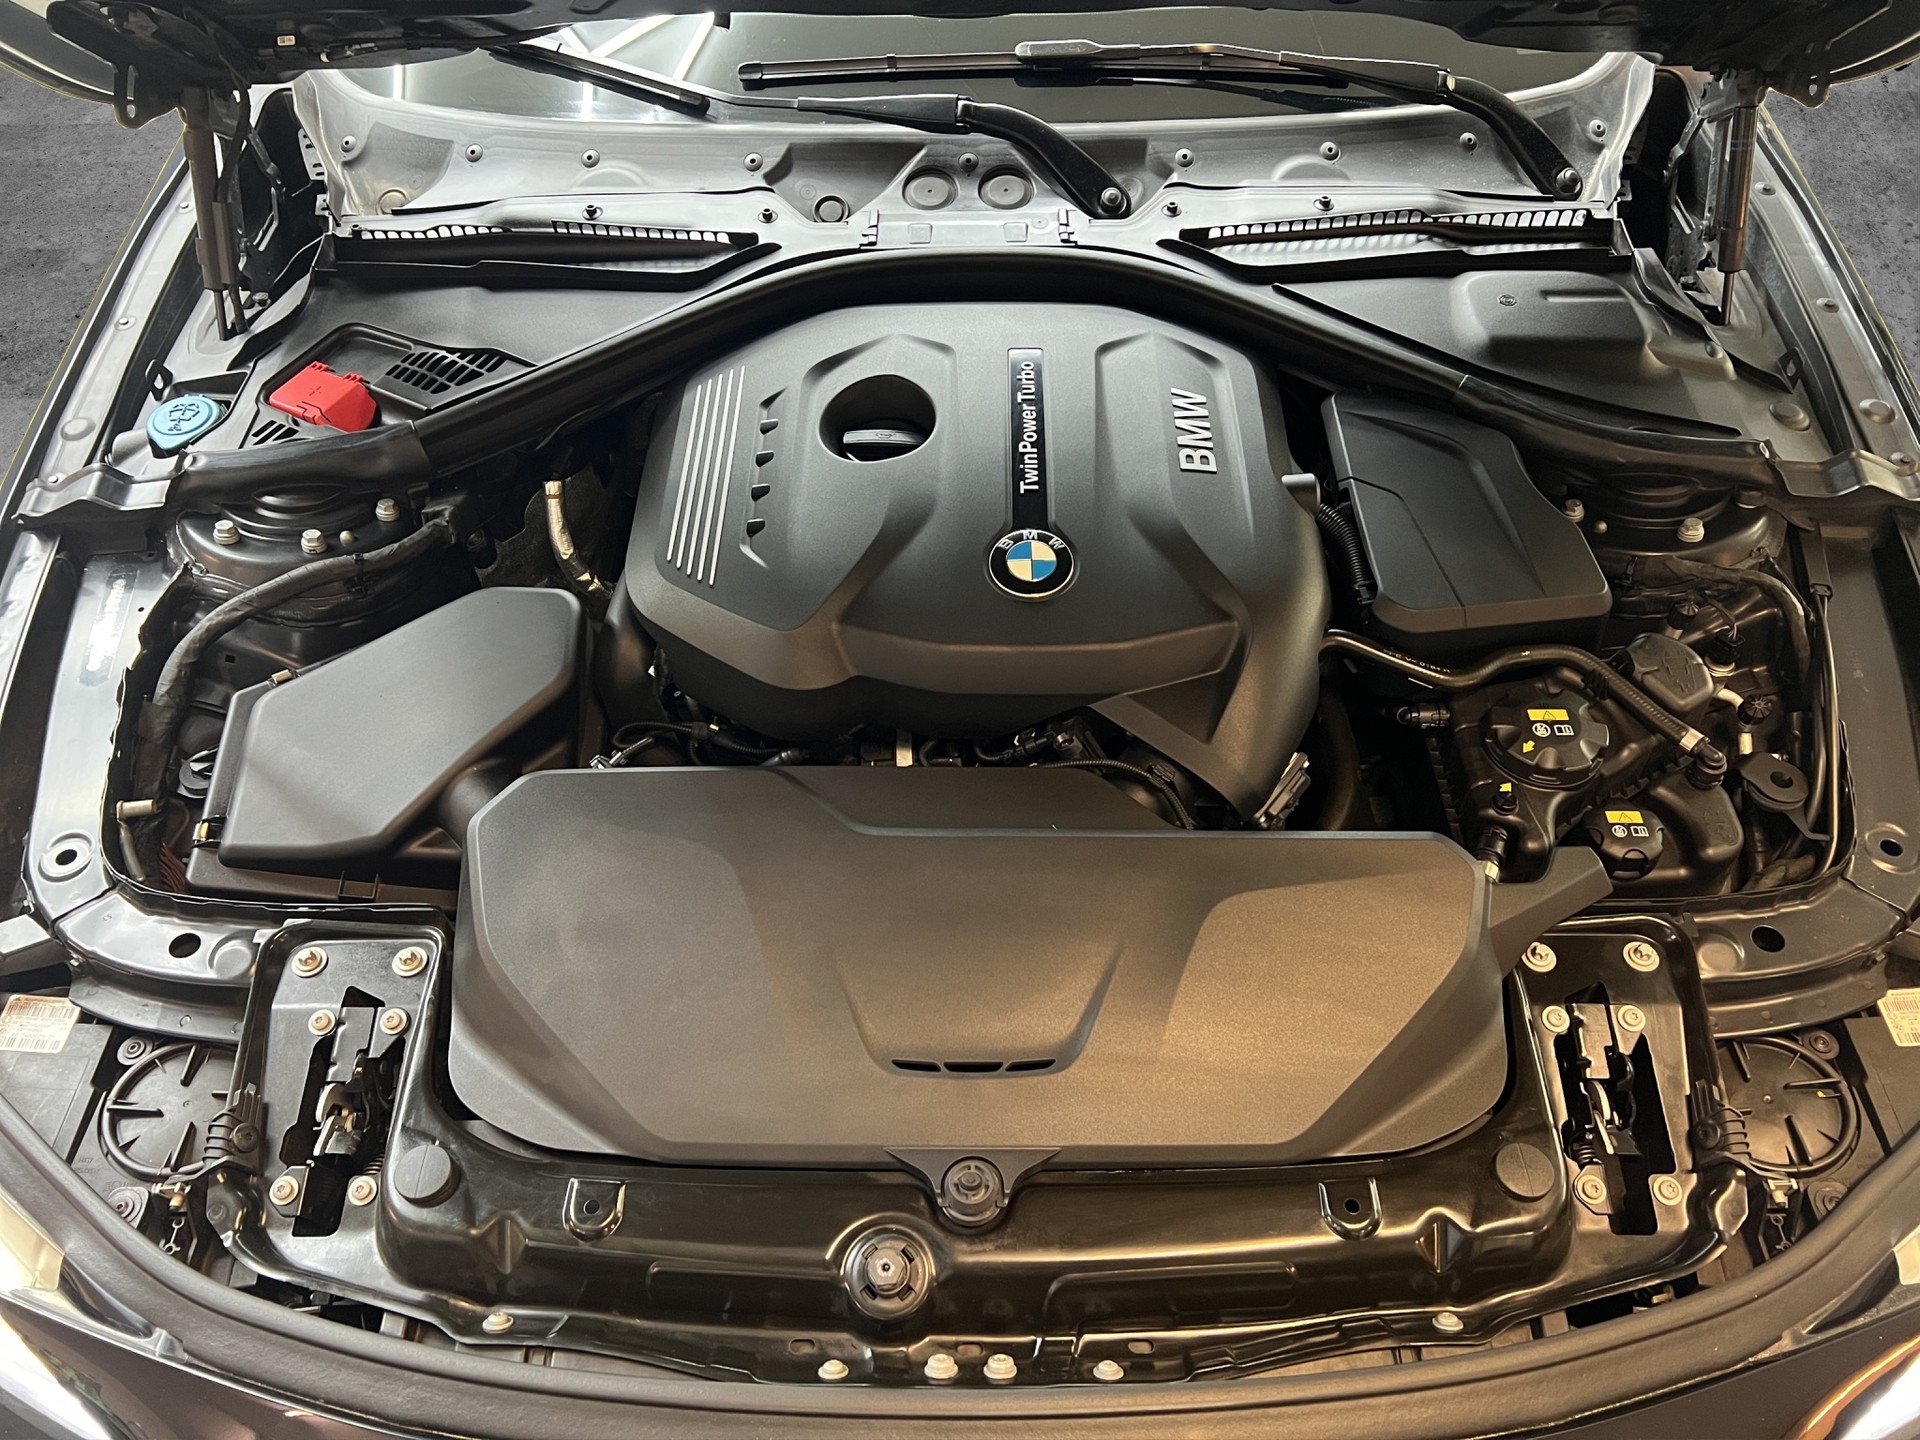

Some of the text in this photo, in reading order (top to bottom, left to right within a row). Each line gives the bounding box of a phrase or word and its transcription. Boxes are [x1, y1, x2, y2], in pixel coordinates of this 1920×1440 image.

[1016, 361, 1039, 494] TwinPower Turbo
[1170, 387, 1218, 473] BMW
[997, 530, 1065, 551] BMW
